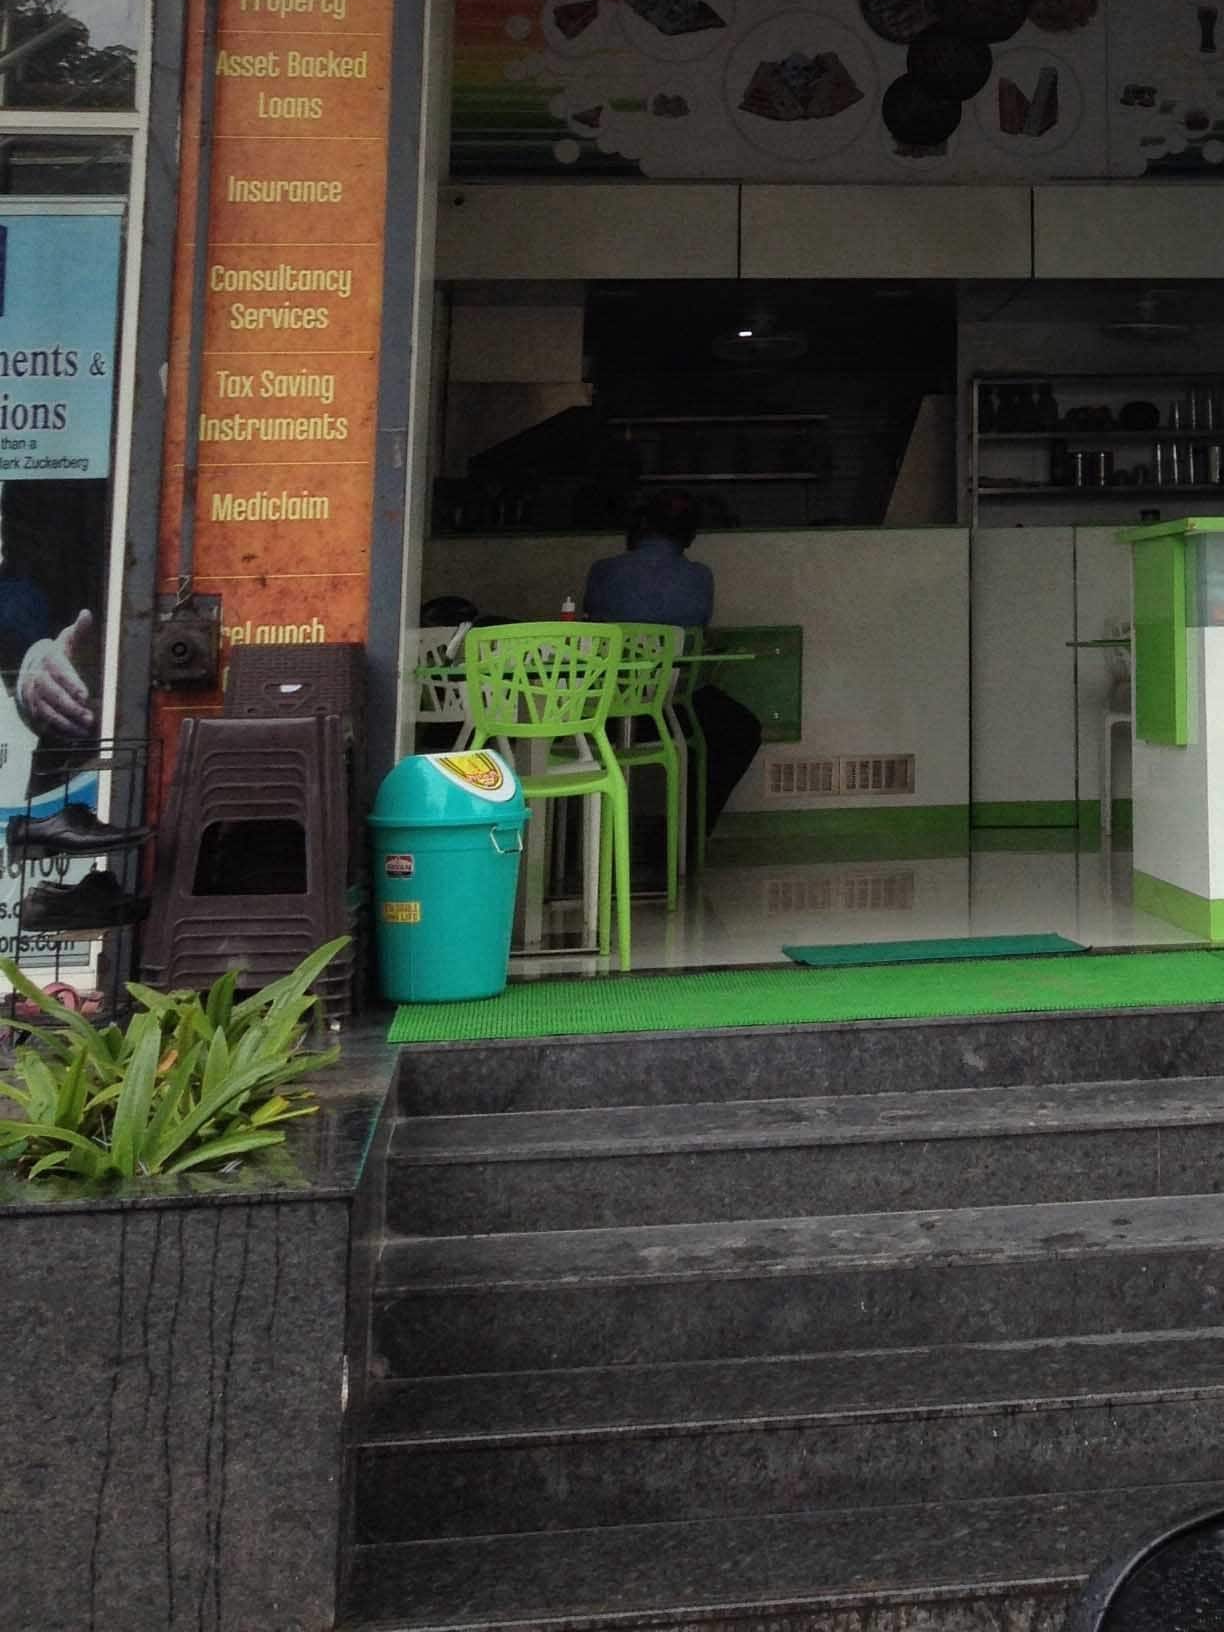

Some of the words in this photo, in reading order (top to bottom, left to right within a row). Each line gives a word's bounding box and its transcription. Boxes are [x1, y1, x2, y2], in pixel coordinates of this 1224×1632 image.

[216, 50, 280, 78] Asset
[287, 50, 369, 79] Backed
[258, 91, 323, 119] Loans
[227, 175, 343, 204] Insurance
[210, 263, 352, 297] Consultancy
[230, 302, 329, 331] Services
[89, 351, 106, 377] &
[216, 370, 253, 399] Tax
[260, 369, 335, 404] Saving
[200, 413, 348, 441] Instruments
[211, 491, 330, 522] Mediclaim
